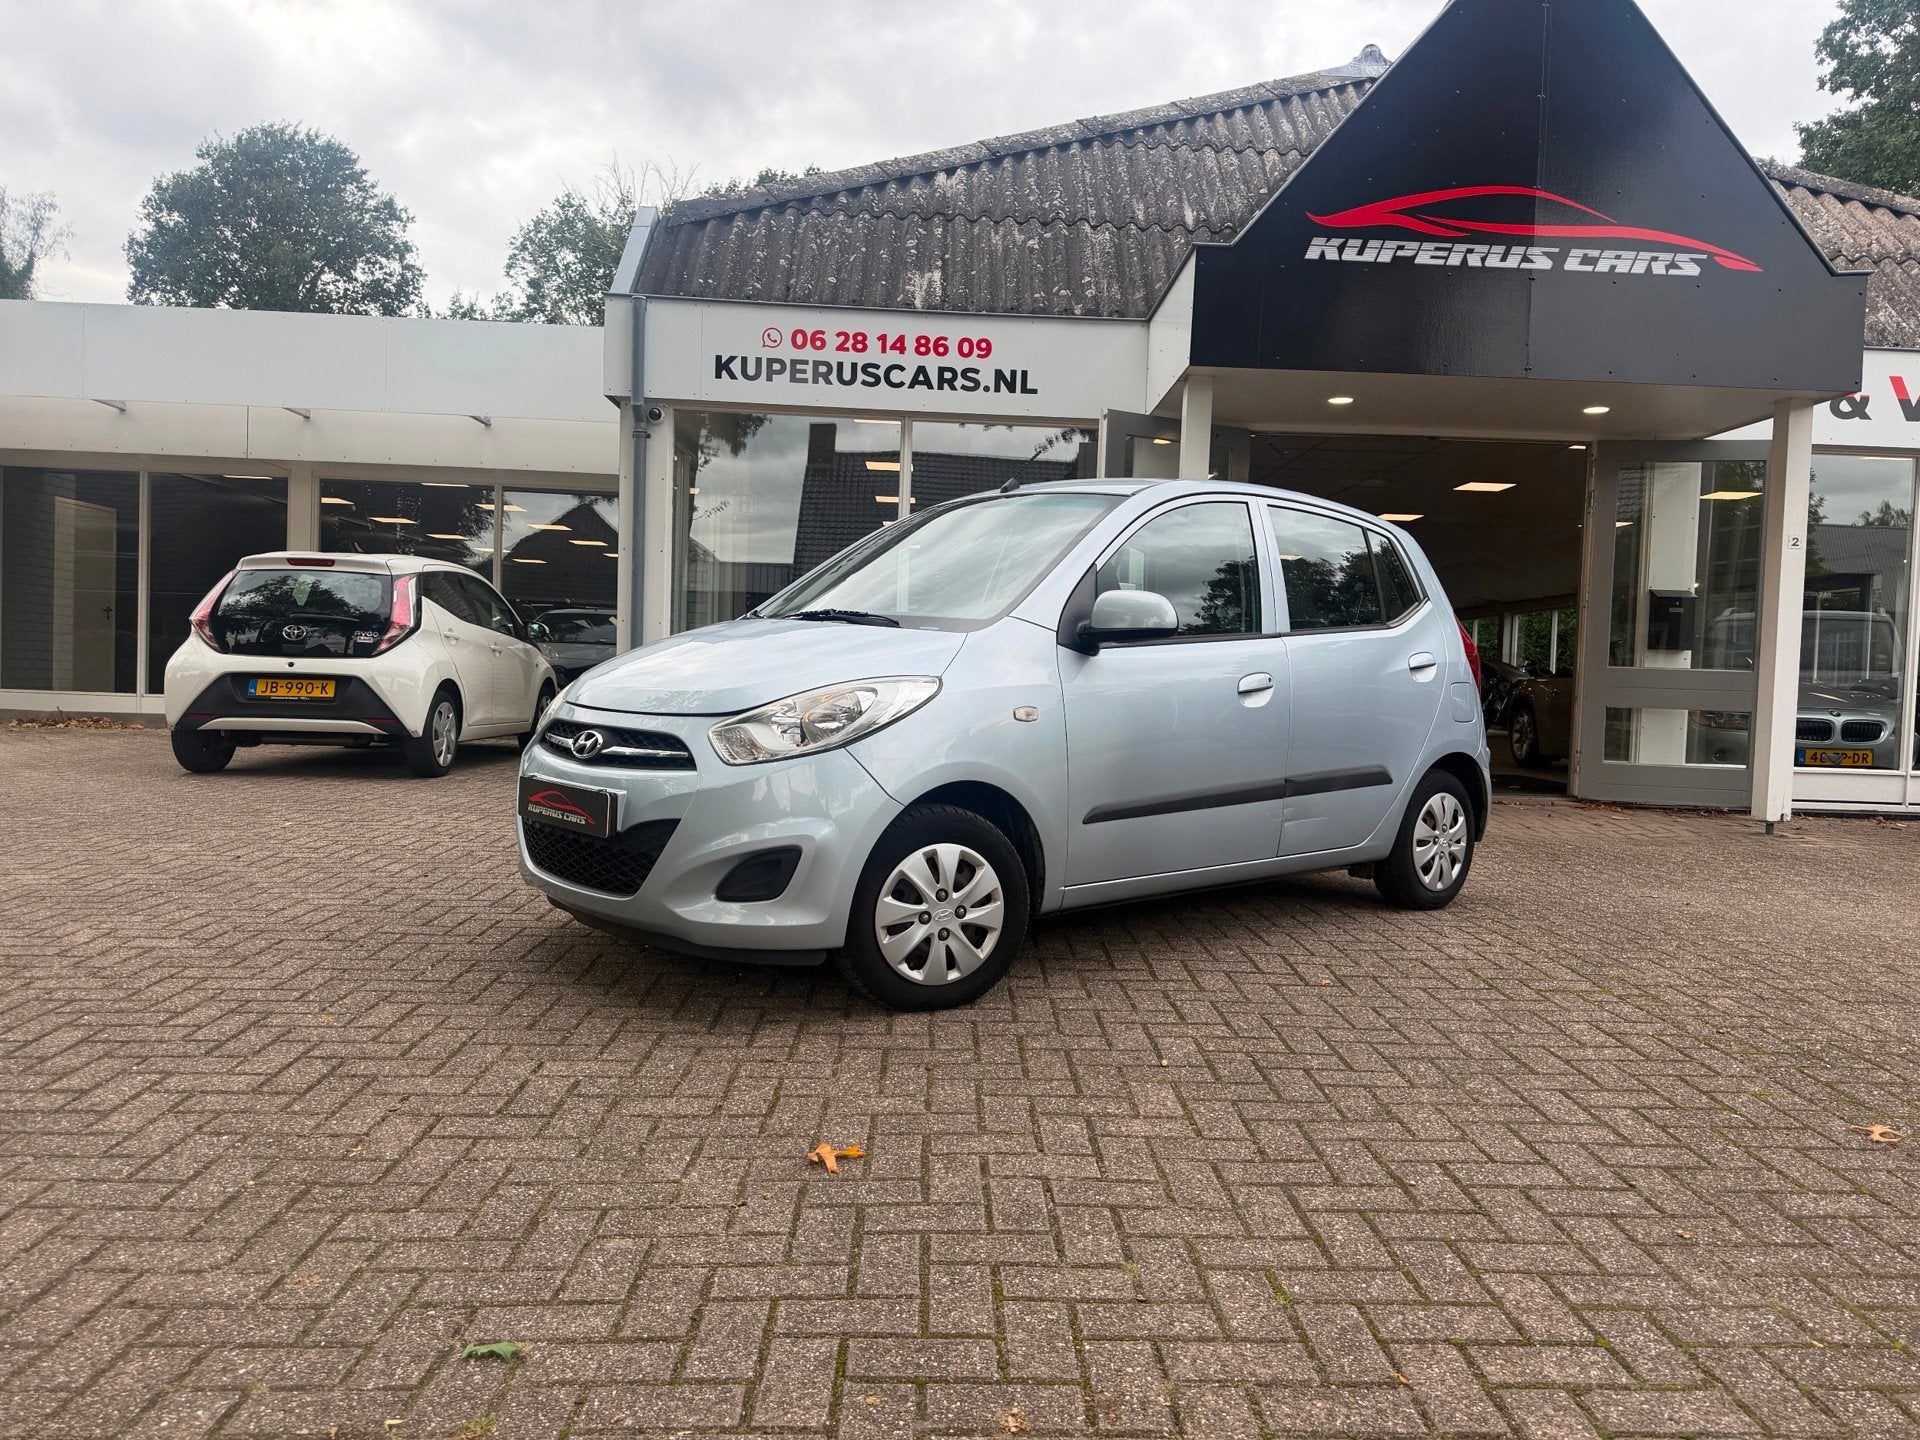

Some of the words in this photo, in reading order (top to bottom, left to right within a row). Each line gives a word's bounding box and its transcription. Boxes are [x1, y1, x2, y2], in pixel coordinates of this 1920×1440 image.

[1304, 236, 1559, 269] KUPERUS
[1563, 247, 1708, 276] CARS
[790, 328, 827, 351] 06
[835, 331, 869, 353] 28
[876, 333, 906, 355] 14
[914, 335, 949, 357] 86
[957, 337, 993, 359] 09
[714, 354, 1038, 394] KUPERUSCARS.NL
[1791, 537, 1799, 547] 2
[260, 681, 329, 695] JB-990-K
[527, 803, 562, 819] KUPERUS
[563, 812, 586, 825] CARS
